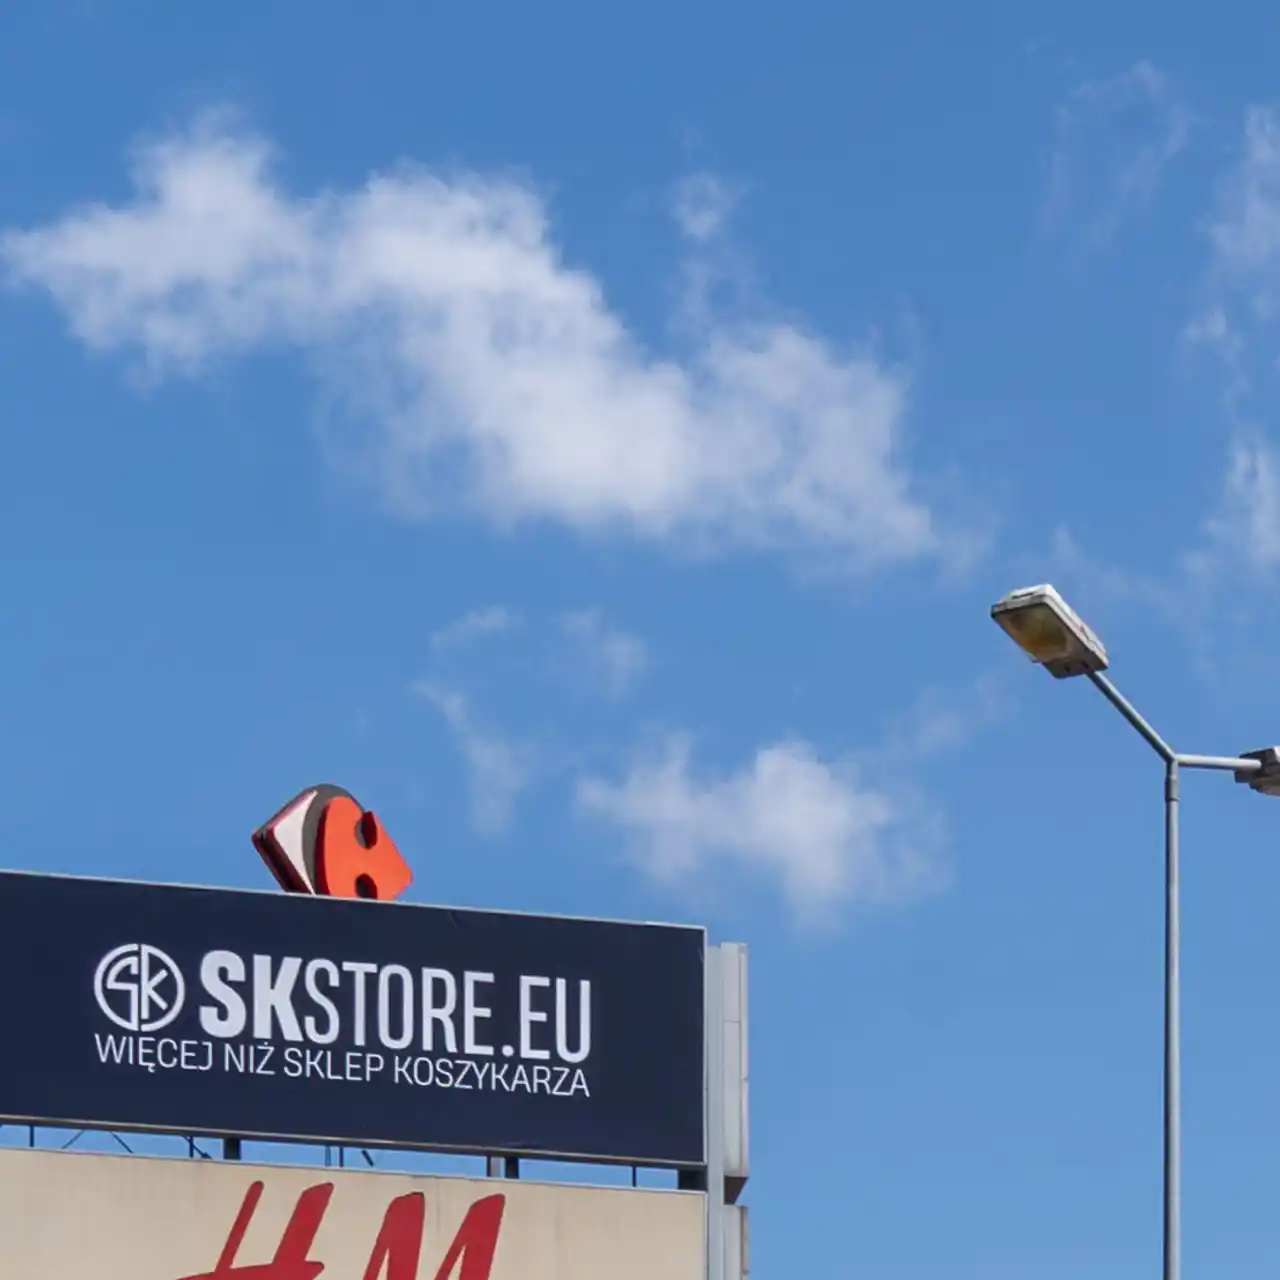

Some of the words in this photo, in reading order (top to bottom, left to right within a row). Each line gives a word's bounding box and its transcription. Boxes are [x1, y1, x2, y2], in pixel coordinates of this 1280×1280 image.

[200, 949, 592, 1064] SKSTORE.EU
[95, 1033, 214, 1073] WIĘCEJ
[224, 1042, 276, 1075] NIŻ
[284, 1047, 384, 1083] SKLEP
[395, 1055, 591, 1098] KOSZYKARZA
